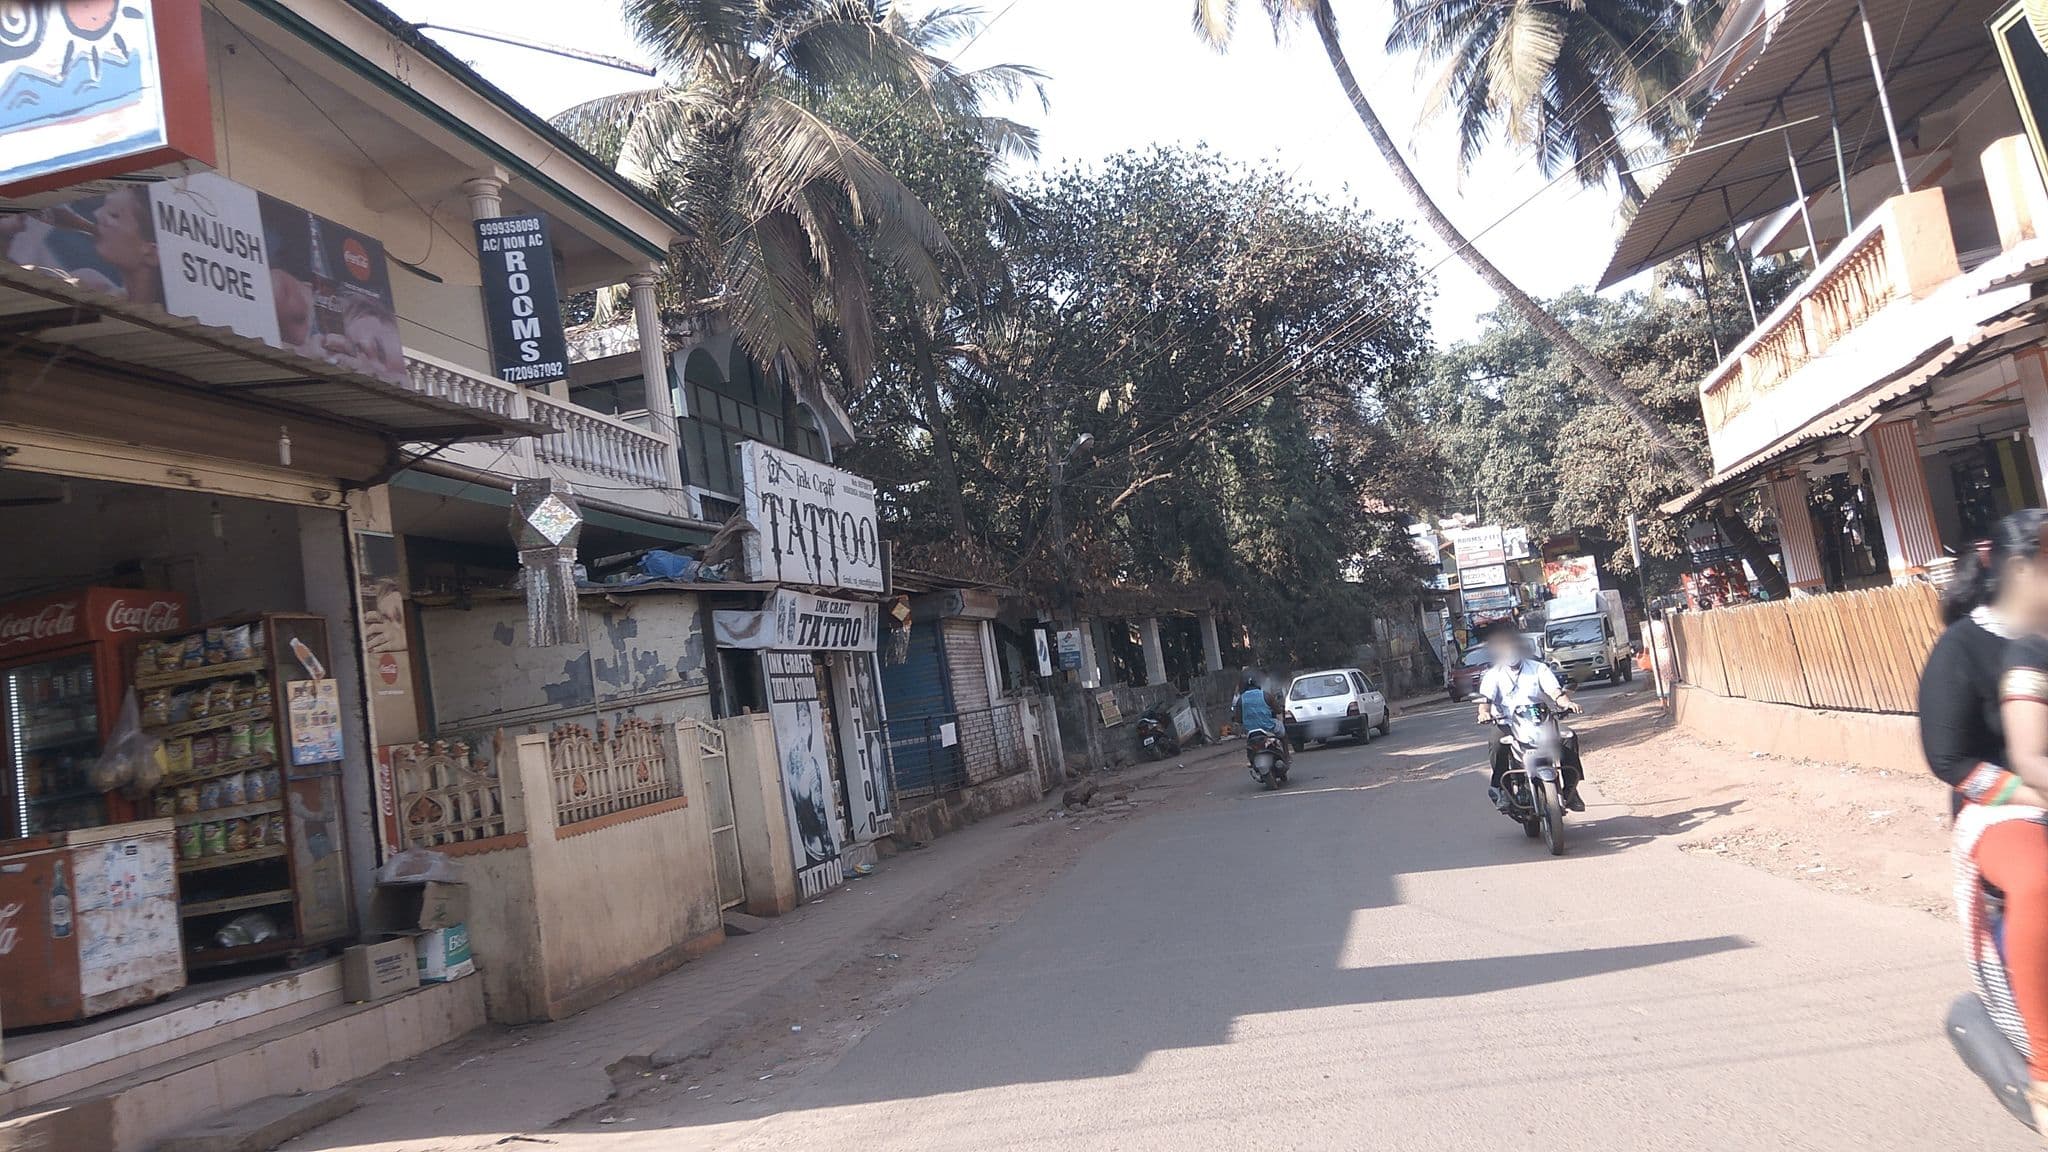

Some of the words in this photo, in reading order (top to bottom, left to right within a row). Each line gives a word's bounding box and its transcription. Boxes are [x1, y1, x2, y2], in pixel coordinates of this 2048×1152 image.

[158, 200, 264, 264] MANJUSH
[503, 235, 526, 249] NON
[529, 233, 543, 247] AC
[183, 252, 256, 301] STORE
[505, 251, 541, 362] ROOMS
[813, 472, 836, 496] Craft
[761, 491, 876, 587] TATTOO
[815, 599, 829, 612] INK
[829, 601, 851, 614] CRAFT
[797, 613, 862, 648] TATTOO
[768, 653, 784, 674] INK
[783, 653, 814, 674] CRAFTS
[771, 678, 796, 701] TATTOO
[799, 858, 843, 899] TATTOO
